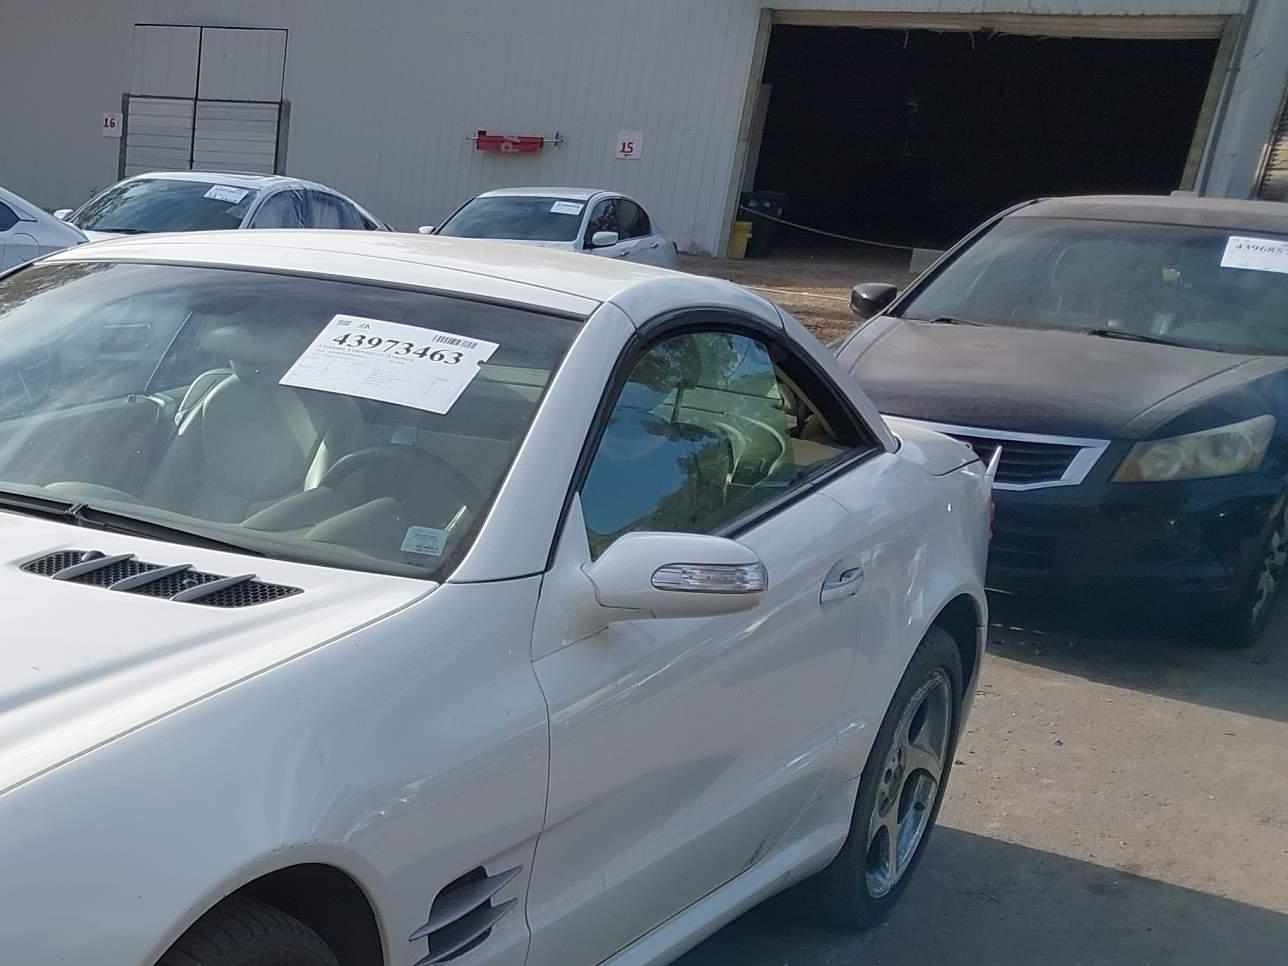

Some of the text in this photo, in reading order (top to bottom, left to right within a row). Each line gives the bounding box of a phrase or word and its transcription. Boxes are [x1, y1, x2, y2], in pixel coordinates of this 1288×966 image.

[103, 118, 116, 128] 16
[620, 142, 634, 153] 15
[332, 332, 464, 365] 43973463
